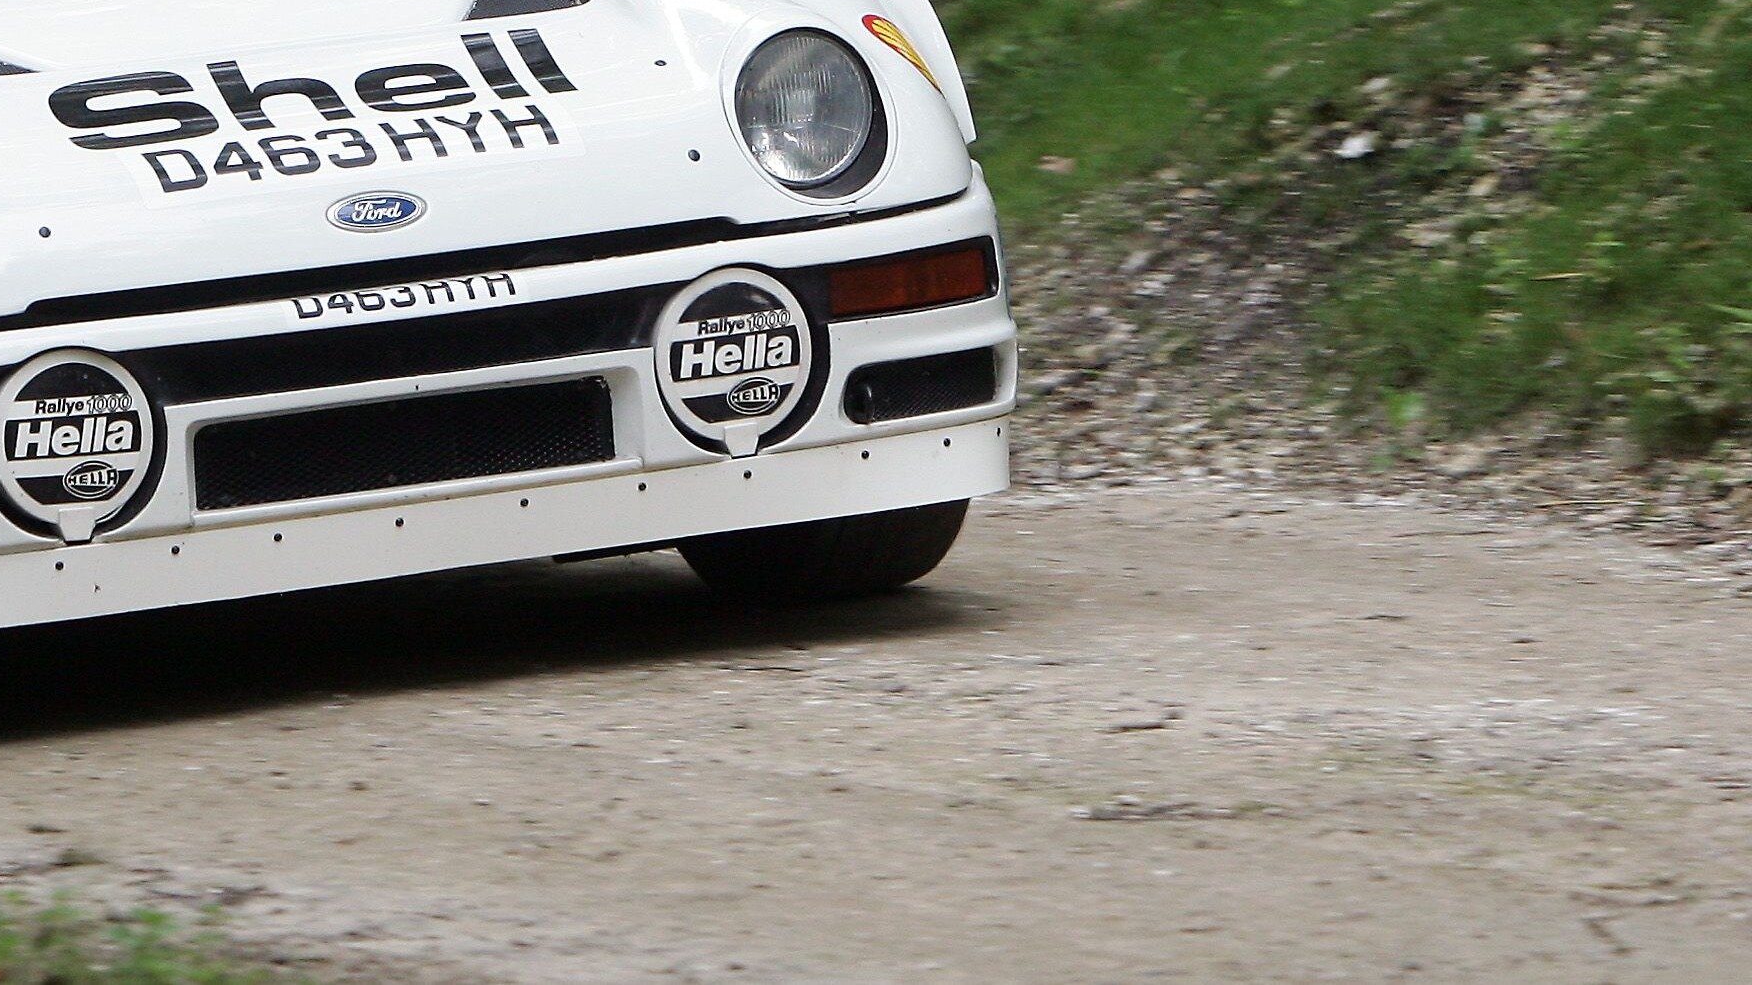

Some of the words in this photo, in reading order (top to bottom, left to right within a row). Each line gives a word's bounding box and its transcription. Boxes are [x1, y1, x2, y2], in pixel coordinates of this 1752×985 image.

[48, 28, 578, 151] Shell
[141, 130, 377, 193] D463
[377, 104, 560, 162] HYH
[352, 199, 403, 222] Ford
[698, 317, 745, 336] Rallye
[747, 309, 791, 332] 1000
[680, 333, 793, 379] Hella
[34, 398, 85, 417] Rallye
[87, 393, 133, 414] 1000
[731, 382, 779, 402] HELLA
[14, 416, 134, 458] Hella
[67, 468, 118, 486] HELLA
